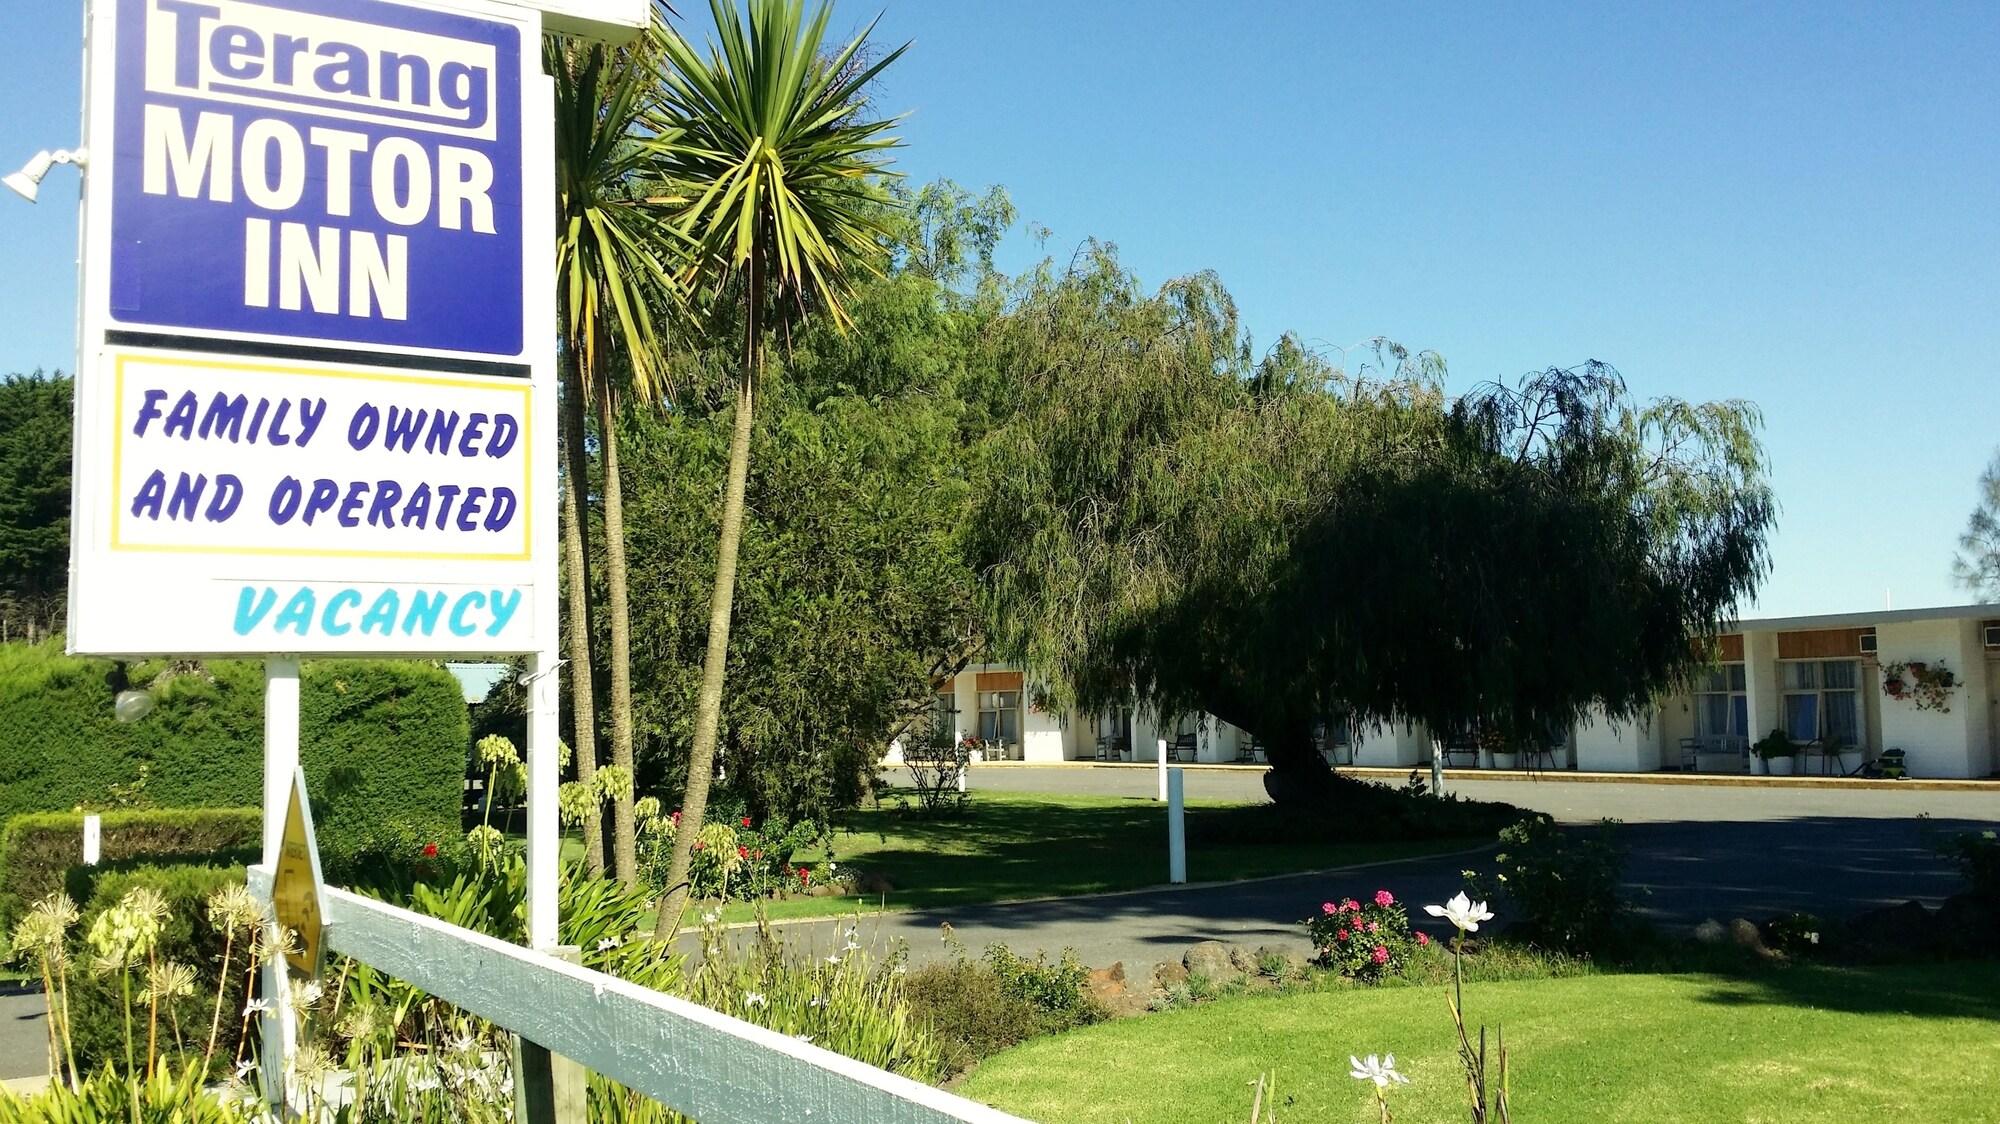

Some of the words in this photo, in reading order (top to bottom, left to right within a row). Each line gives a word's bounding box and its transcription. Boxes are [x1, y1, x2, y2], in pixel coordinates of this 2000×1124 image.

[156, 0, 488, 129] Terang
[143, 103, 498, 235] MOTOR
[244, 217, 408, 321] INN
[133, 389, 327, 448] FAMILY
[347, 402, 519, 459] OWNED
[131, 469, 244, 523] AND
[268, 475, 517, 533] OPERATED
[233, 586, 522, 637] VACANCY
